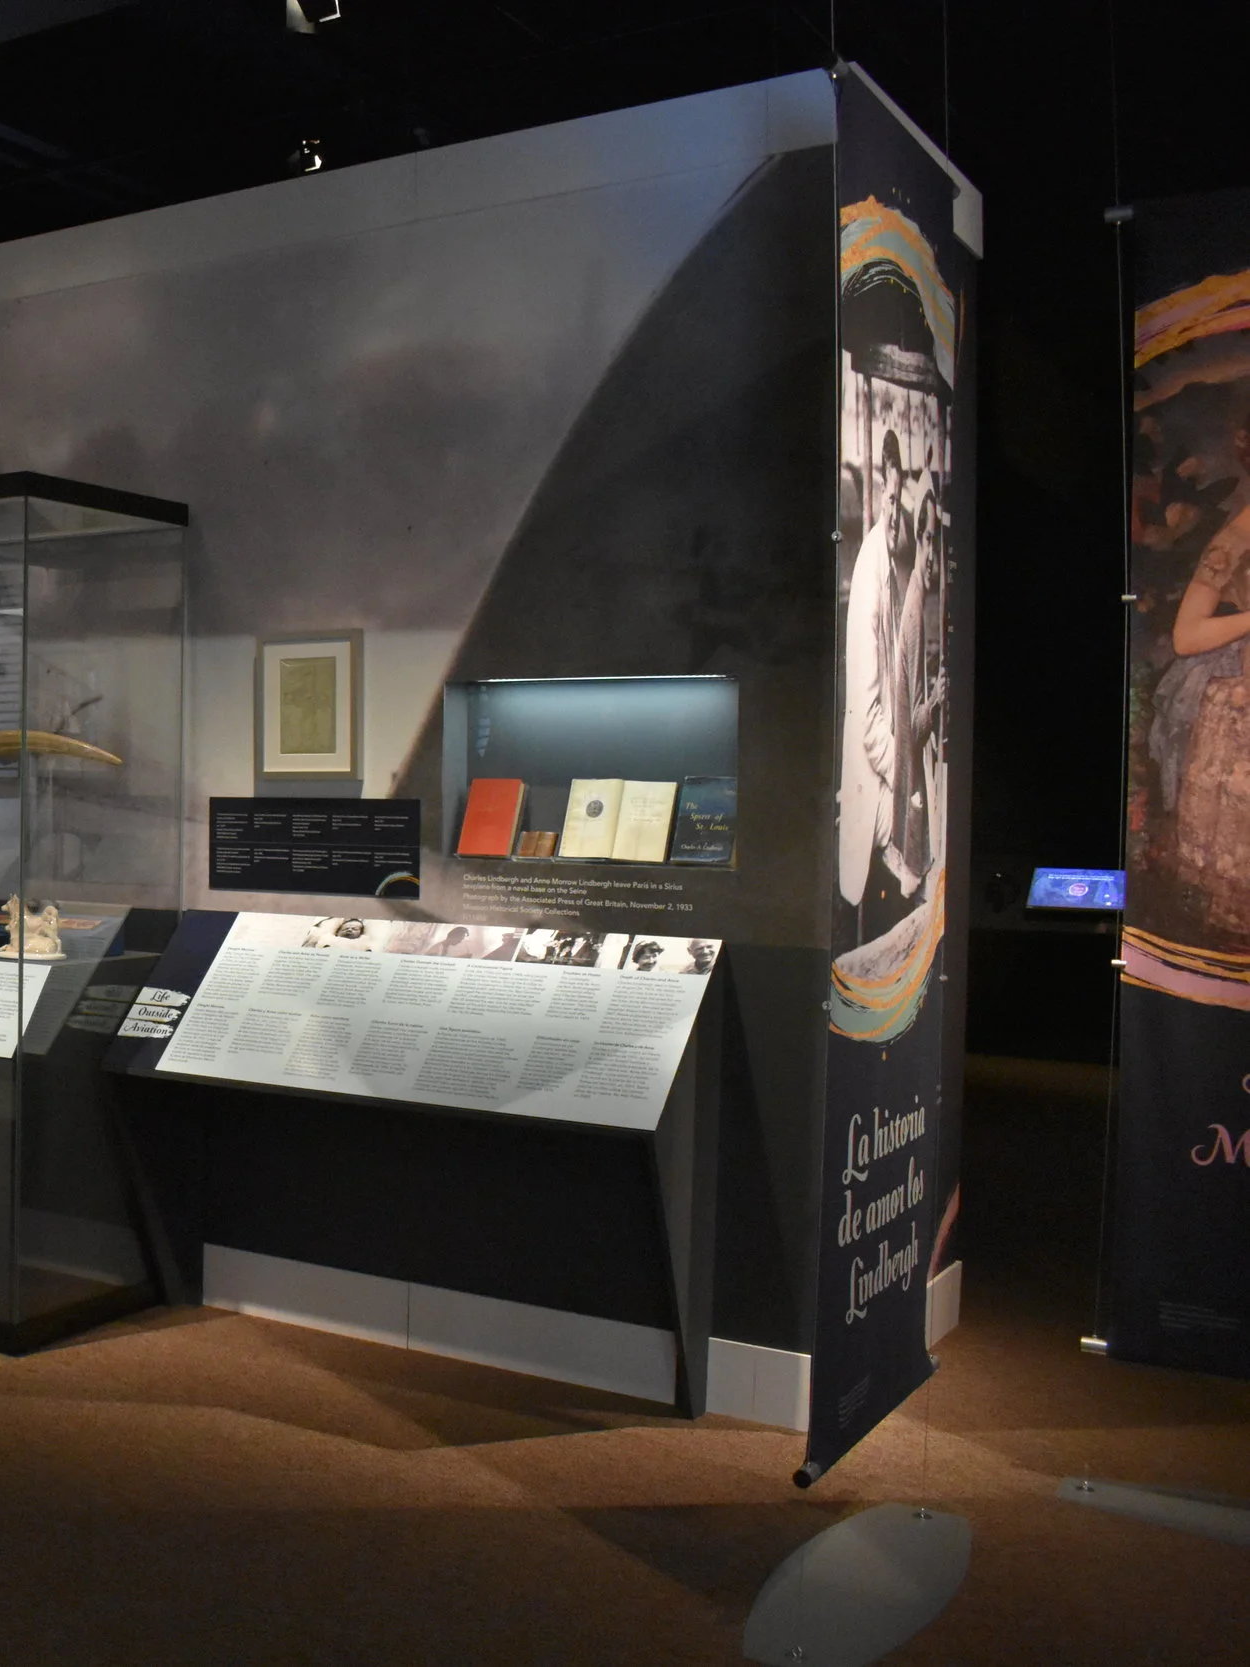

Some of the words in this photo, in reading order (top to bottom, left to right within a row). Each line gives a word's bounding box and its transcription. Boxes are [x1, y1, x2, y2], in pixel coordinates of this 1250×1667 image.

[685, 802, 699, 810] The
[463, 873, 486, 882] Charles
[487, 875, 519, 884] Lindbergh
[533, 877, 550, 885] Anne
[552, 878, 577, 886] Morrow
[578, 879, 612, 889] Lindbergh
[613, 880, 631, 888] leave
[633, 881, 649, 889] Paris
[664, 882, 683, 891] Sirius
[492, 883, 506, 891] from
[531, 885, 546, 893] base
[557, 886, 568, 894] the
[569, 887, 587, 895] Seine
[463, 892, 500, 902] Photograph
[500, 894, 508, 903] by
[522, 896, 557, 904] Associated
[558, 897, 575, 905] Press
[584, 898, 603, 907] Great
[604, 899, 628, 908] Britain,
[630, 901, 666, 909] November
[667, 902, 674, 911] 2,
[676, 903, 693, 912] 1933
[490, 904, 519, 913] Historical
[520, 905, 543, 915] Society
[544, 907, 580, 916] Collections
[150, 990, 170, 1003] Life
[138, 1006, 173, 1019] Outside
[123, 1022, 168, 1035] Aviation
[842, 1113, 870, 1185] La
[873, 1094, 926, 1161] historia
[838, 1189, 862, 1248] de
[865, 1182, 905, 1234] amor
[907, 1155, 925, 1209] los
[845, 1221, 919, 1325] Lindbergh
